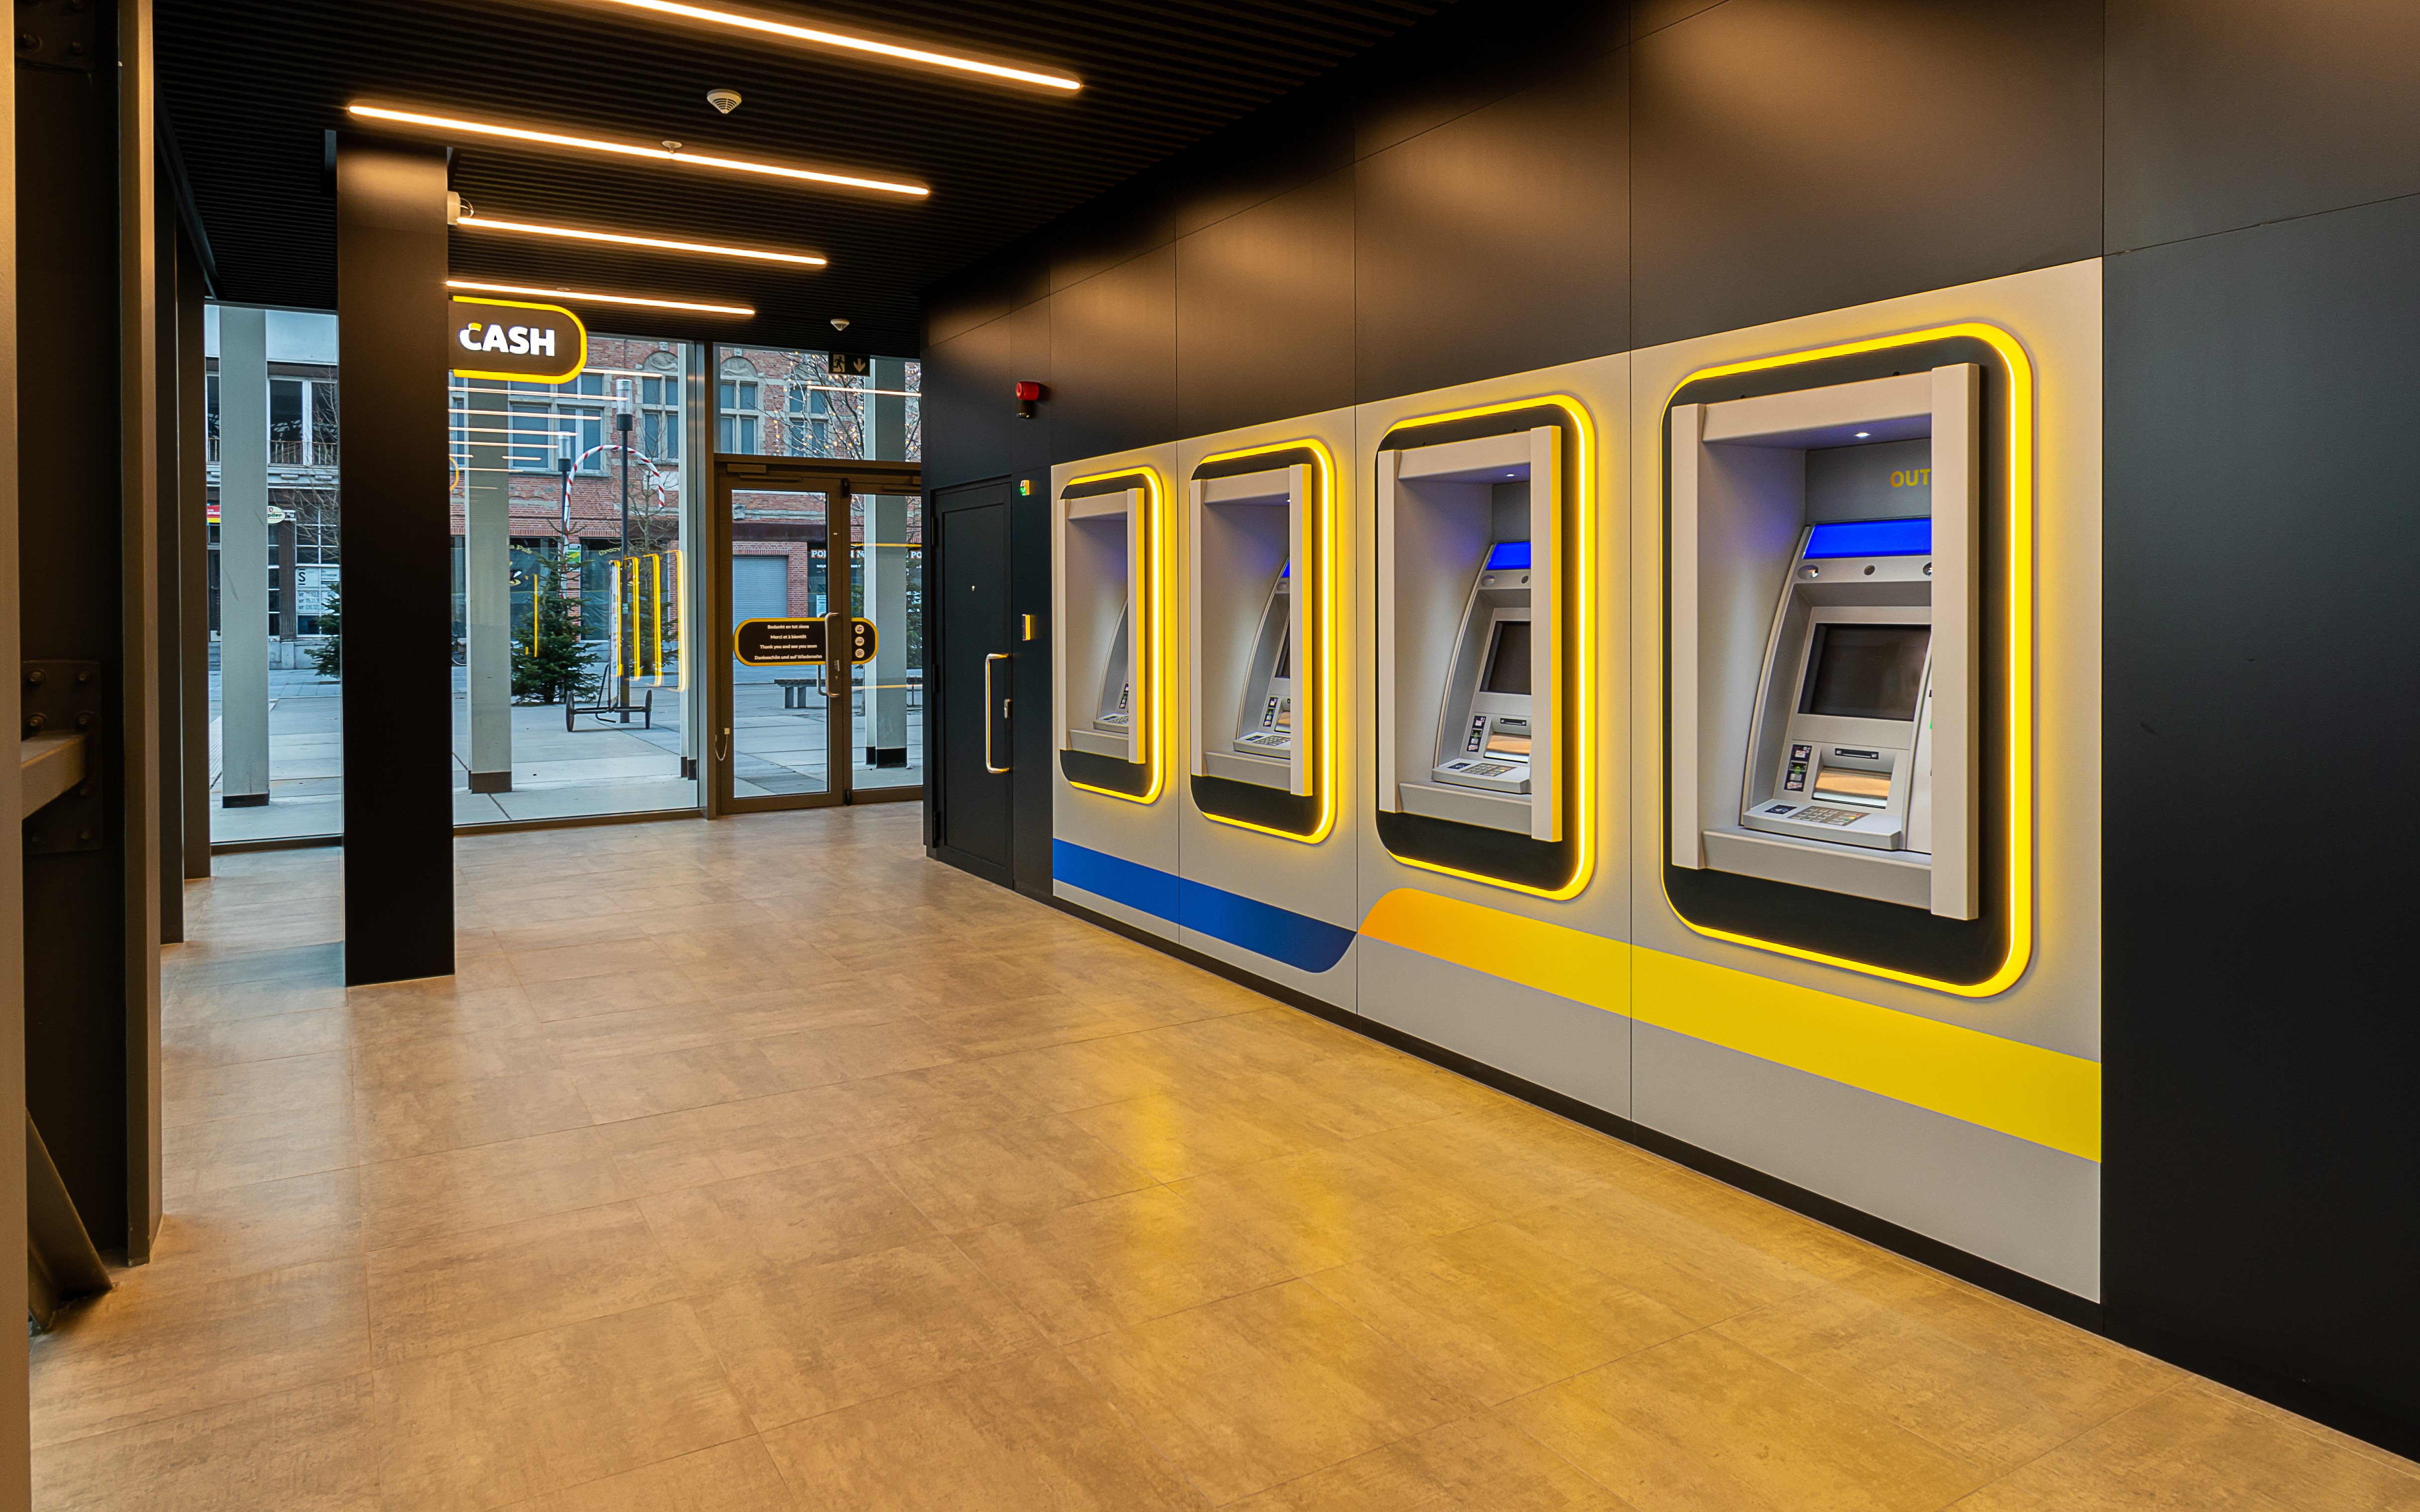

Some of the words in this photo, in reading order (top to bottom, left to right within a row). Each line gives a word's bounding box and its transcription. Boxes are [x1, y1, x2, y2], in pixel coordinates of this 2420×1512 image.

[459, 322, 555, 357] CASH
[1890, 469, 1930, 487] OUT
[516, 545, 532, 554] Pub
